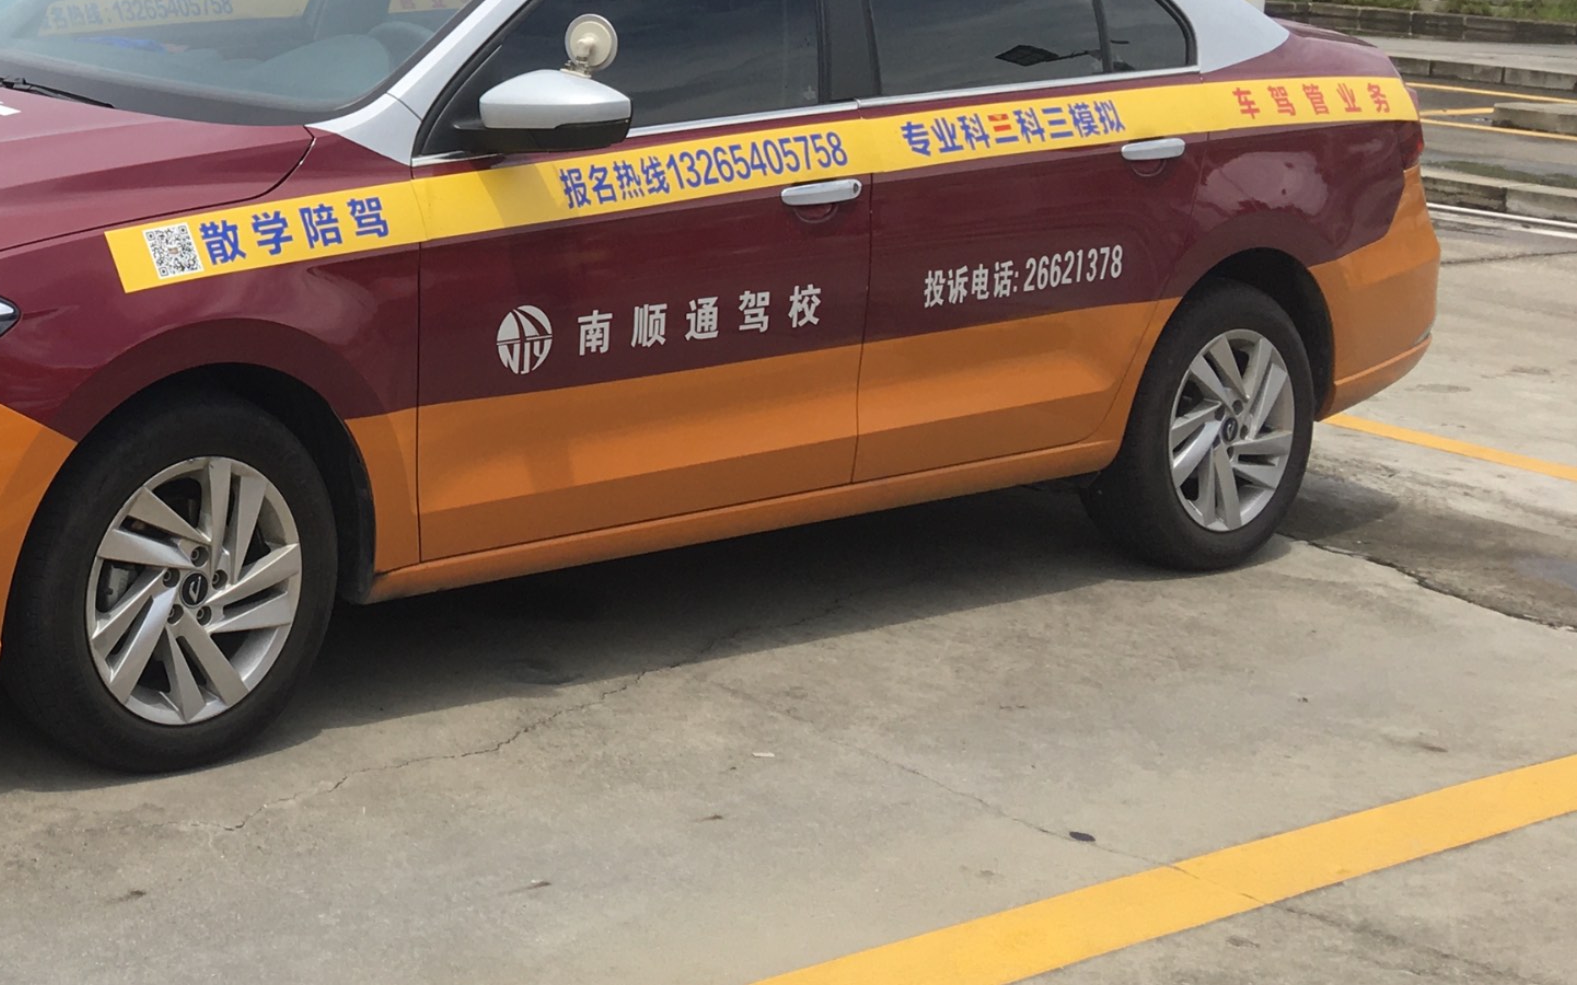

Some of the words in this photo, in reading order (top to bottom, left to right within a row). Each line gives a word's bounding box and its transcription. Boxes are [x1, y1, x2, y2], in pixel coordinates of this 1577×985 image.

[1232, 82, 1391, 120] 车驾管业务
[560, 131, 849, 210] 报名热线13265405758
[198, 196, 390, 266] 散学陪驾
[577, 284, 822, 356] 南顺通驾校
